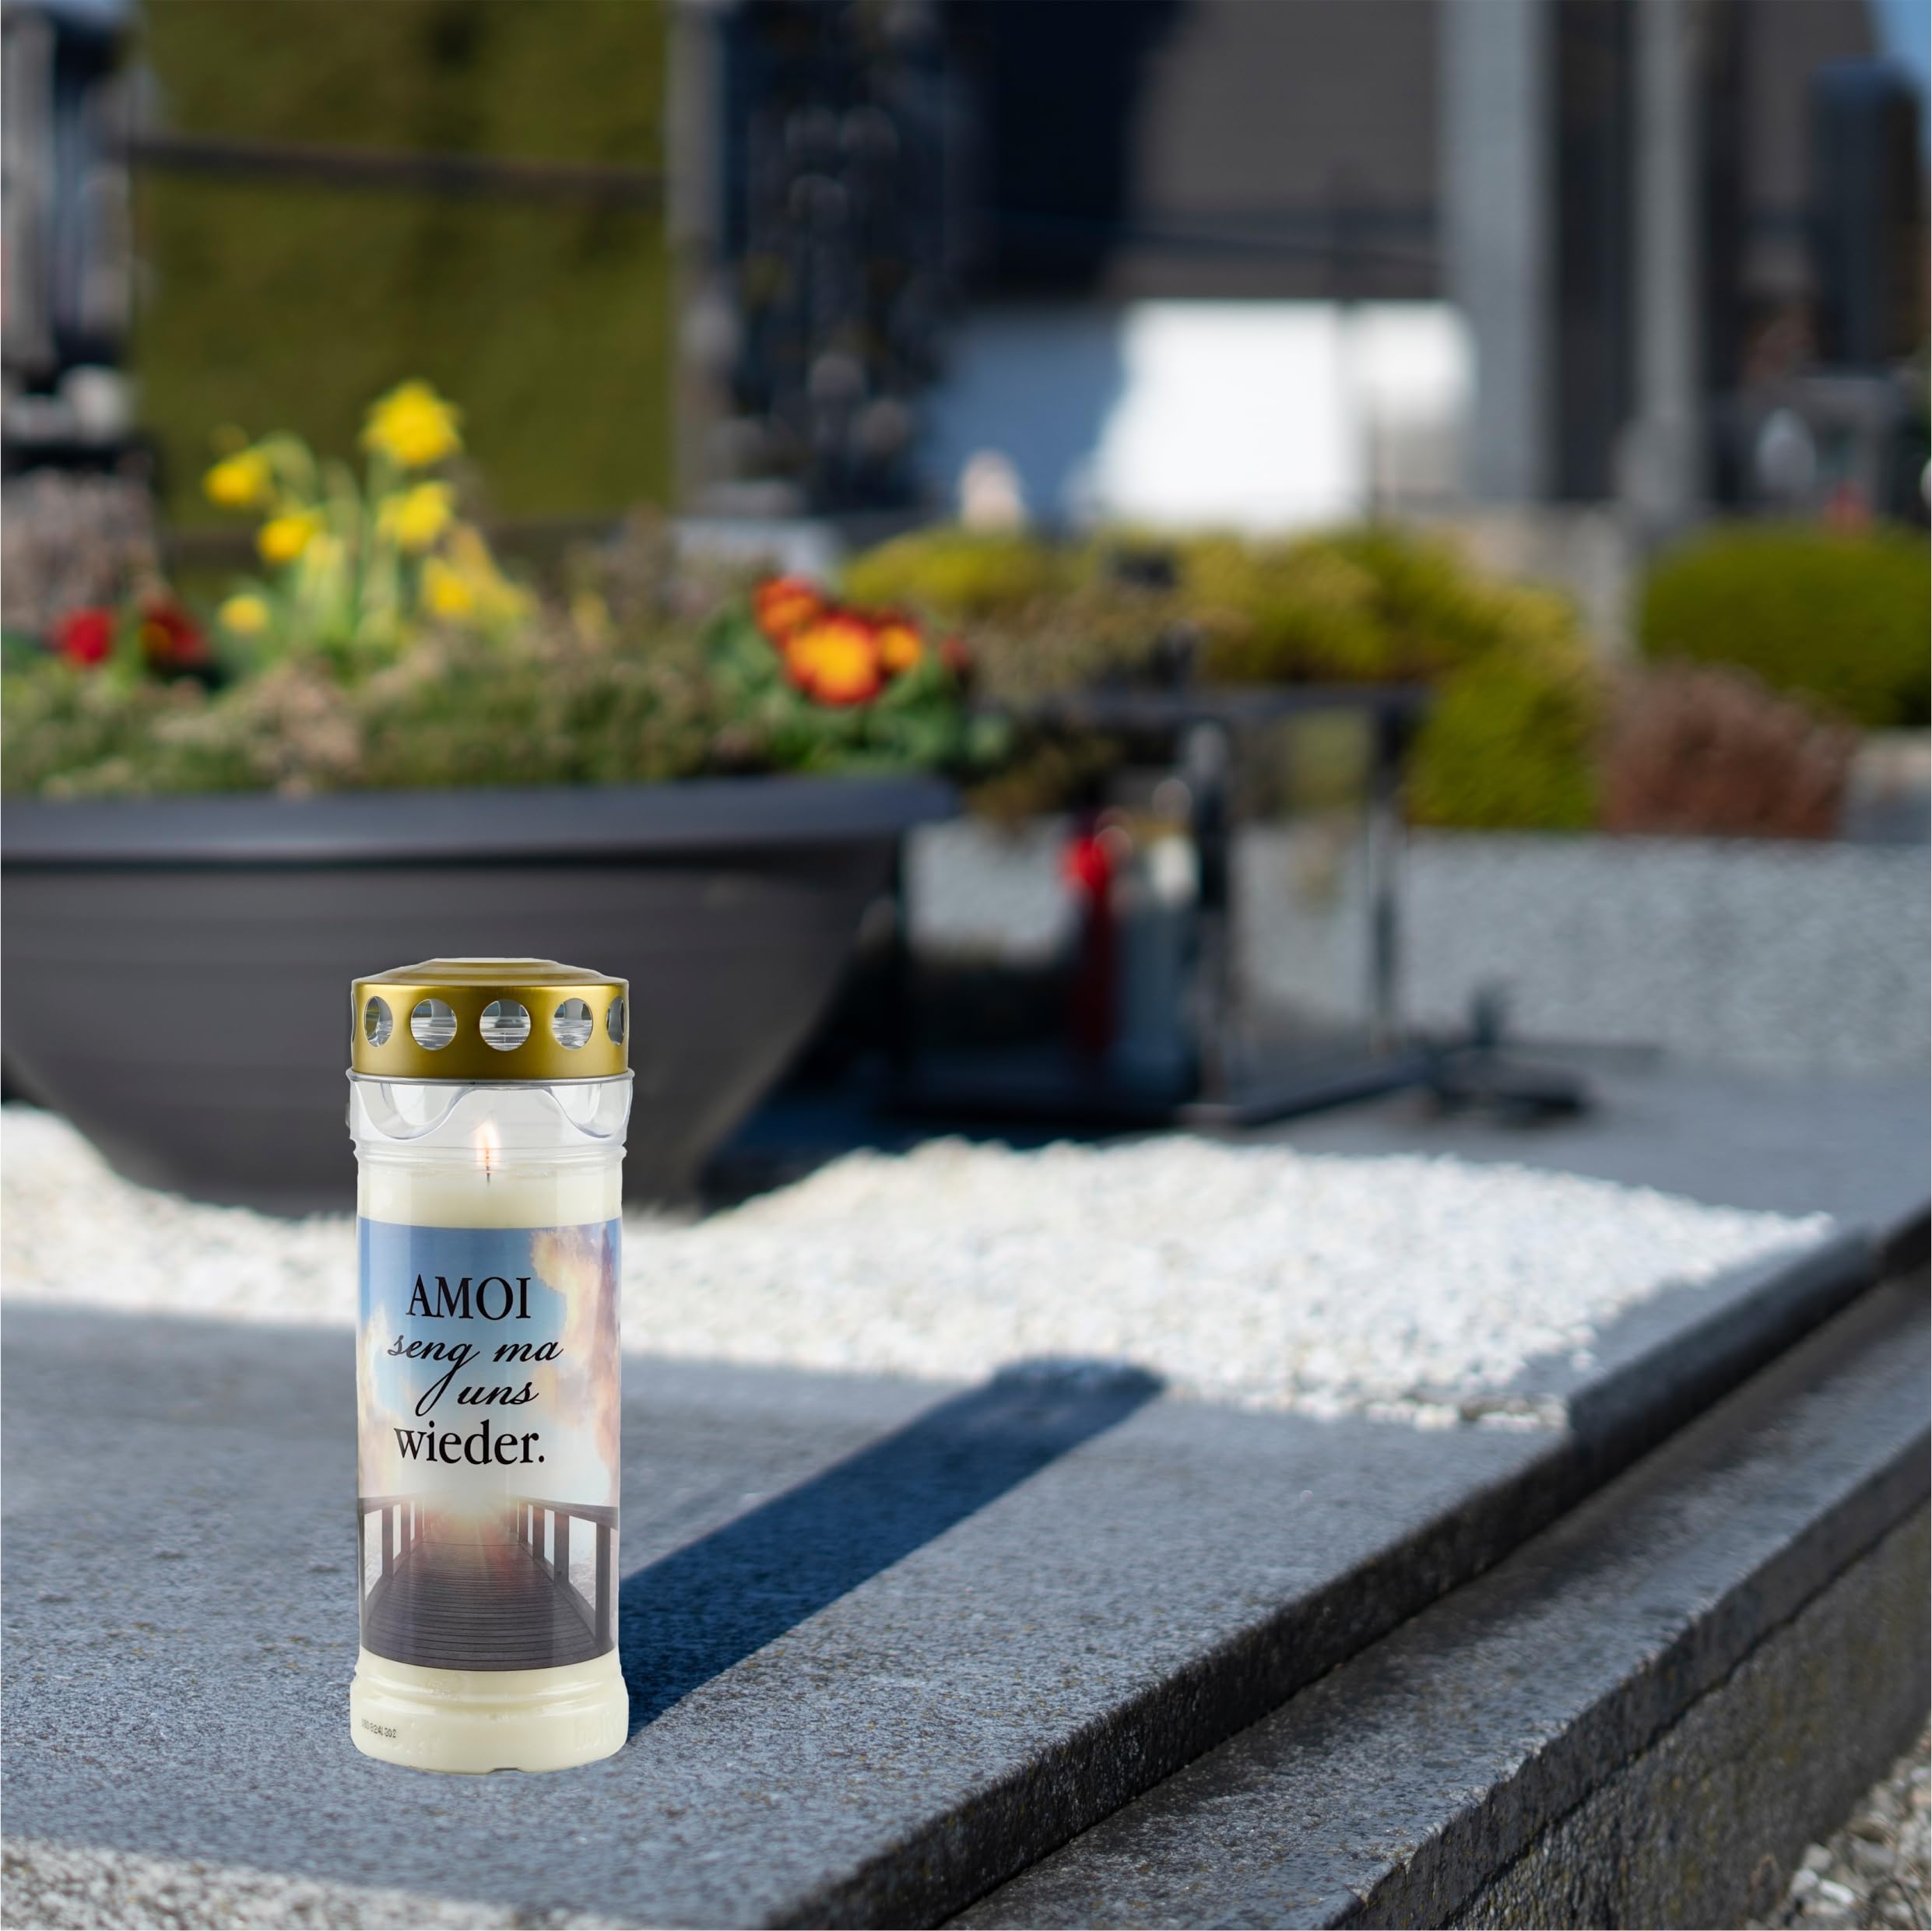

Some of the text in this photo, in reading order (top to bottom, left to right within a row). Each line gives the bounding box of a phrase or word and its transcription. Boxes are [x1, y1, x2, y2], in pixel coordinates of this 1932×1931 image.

[406, 1273, 532, 1321] AMOI
[387, 1335, 564, 1417] seng ma
[456, 1382, 540, 1406] uns
[393, 1419, 546, 1465] wieder.
